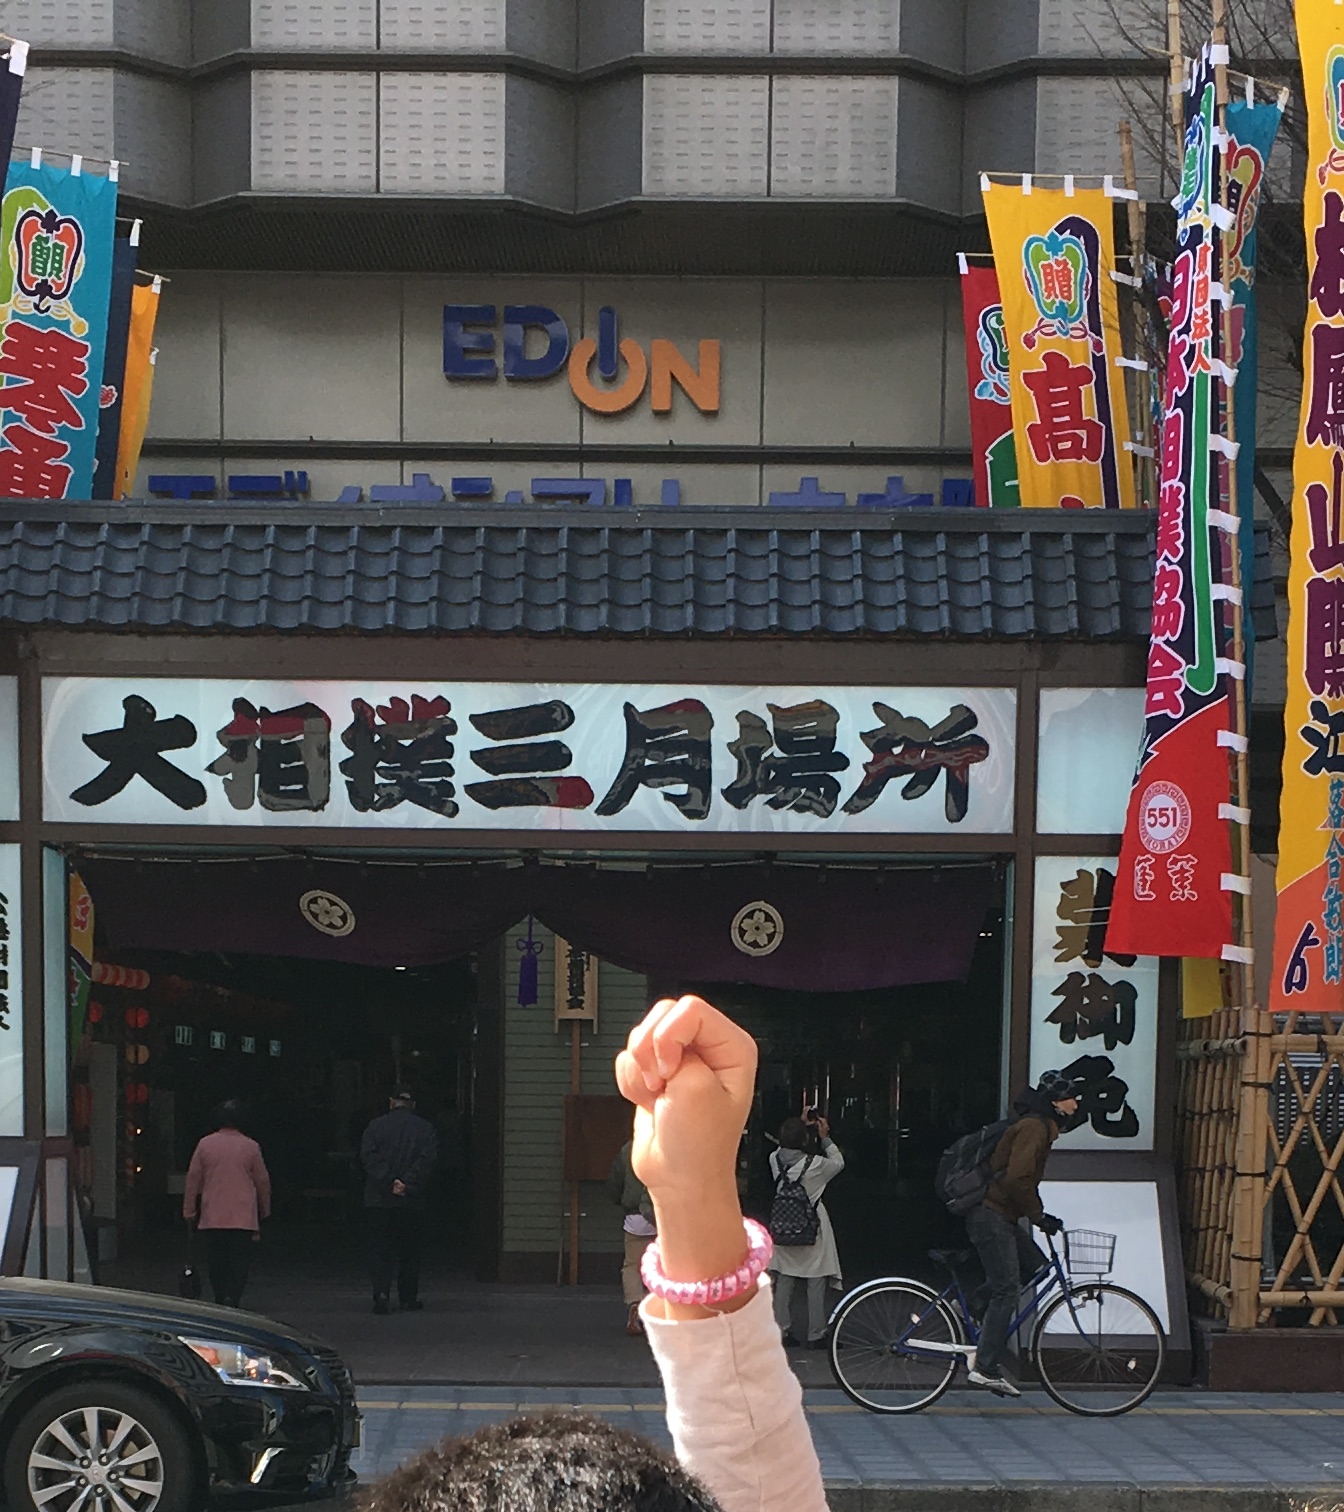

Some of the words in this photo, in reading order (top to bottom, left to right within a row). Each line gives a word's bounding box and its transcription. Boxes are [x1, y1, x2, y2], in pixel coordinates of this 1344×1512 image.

[1041, 259, 1073, 302] 贈
[443, 304, 720, 414] EDION
[68, 692, 992, 824] 大相撲三月場所
[1146, 807, 1179, 829] 551
